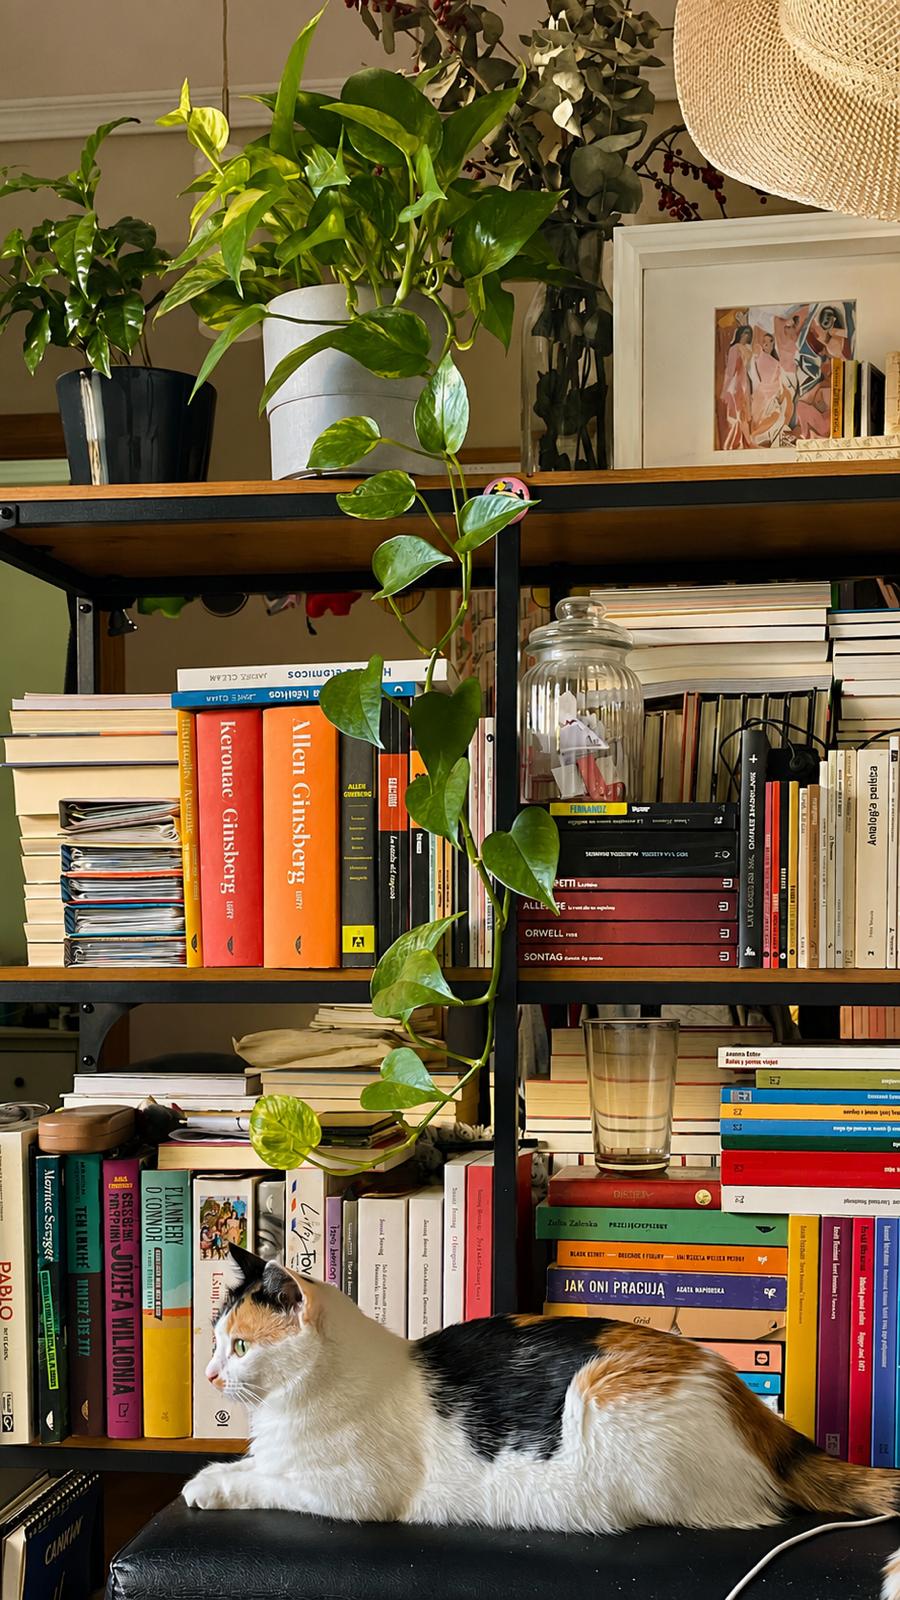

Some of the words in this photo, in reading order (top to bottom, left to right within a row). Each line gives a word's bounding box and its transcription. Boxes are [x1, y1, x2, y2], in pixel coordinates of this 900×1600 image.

[218, 720, 237, 798] Kerouac
[291, 719, 311, 776] Allen
[217, 807, 239, 894] Ginsberg
[287, 782, 311, 885] Ginsberg
[524, 952, 563, 961] SONTAG
[525, 929, 563, 938] ORWELL
[76, 1206, 88, 1228] TEN
[165, 1187, 183, 1245] FLANNERY
[0, 1261, 13, 1320] PABLO
[111, 1244, 139, 1312] JÓZEFA
[564, 1279, 585, 1292] JAK
[589, 1280, 609, 1293] ONI
[613, 1281, 665, 1299] PRACUJĄ
[632, 1315, 651, 1325] Grid
[111, 1318, 135, 1396] WILKONIA
